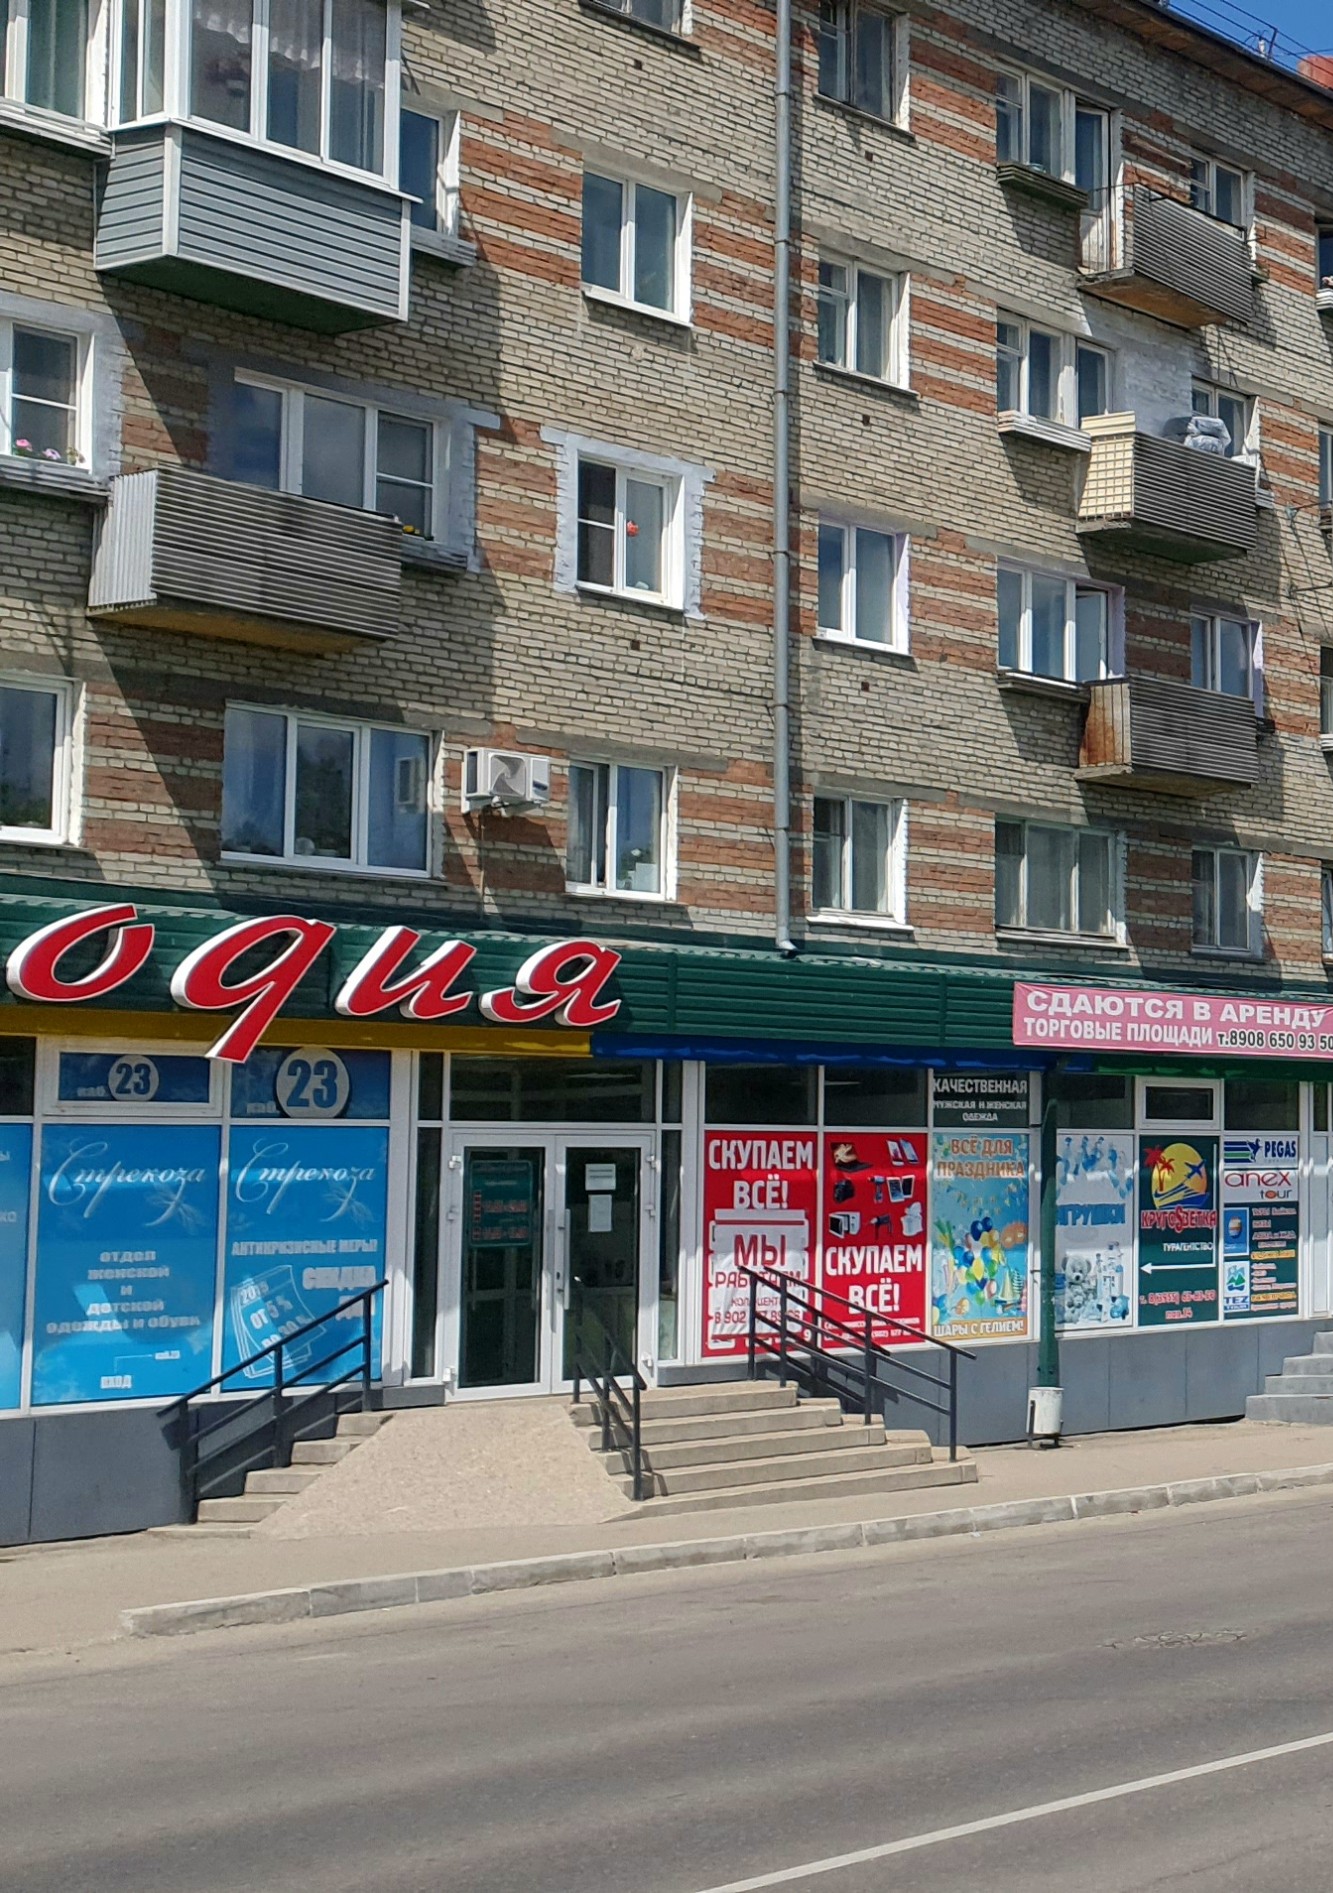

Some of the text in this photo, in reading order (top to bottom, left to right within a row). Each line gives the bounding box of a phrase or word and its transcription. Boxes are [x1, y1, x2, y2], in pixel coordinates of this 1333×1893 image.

[1026, 991, 1325, 1030] СДАЮТСЯ В АРЕНДУ
[1023, 1017, 1122, 1041] ТОРГОВЫЕ
[1127, 1023, 1212, 1047] ПЛОЩАДИ
[1269, 1032, 1294, 1049] 650
[1298, 1033, 1315, 1050] 93
[115, 1063, 151, 1095] 23
[286, 1060, 339, 1108] 23
[933, 1078, 1027, 1094] КАЧЕСТВЕННАЯ
[708, 1139, 813, 1171] СКУПАЕМ
[951, 1136, 1013, 1157] ВСЁ ДЛЯ
[1264, 1140, 1297, 1158] PEGAS
[937, 1161, 1025, 1179] ПРАЗДНИКА
[1225, 1171, 1292, 1188] anex
[733, 1174, 789, 1209] ВСЁ!
[1260, 1189, 1293, 1200] tour
[734, 1233, 787, 1267] МЫ
[825, 1244, 923, 1276] СКУПАЕМ
[848, 1278, 900, 1315] ВСЁ!
[934, 1319, 1025, 1337] ШАРЫ С ГЕЛИЕМ!
